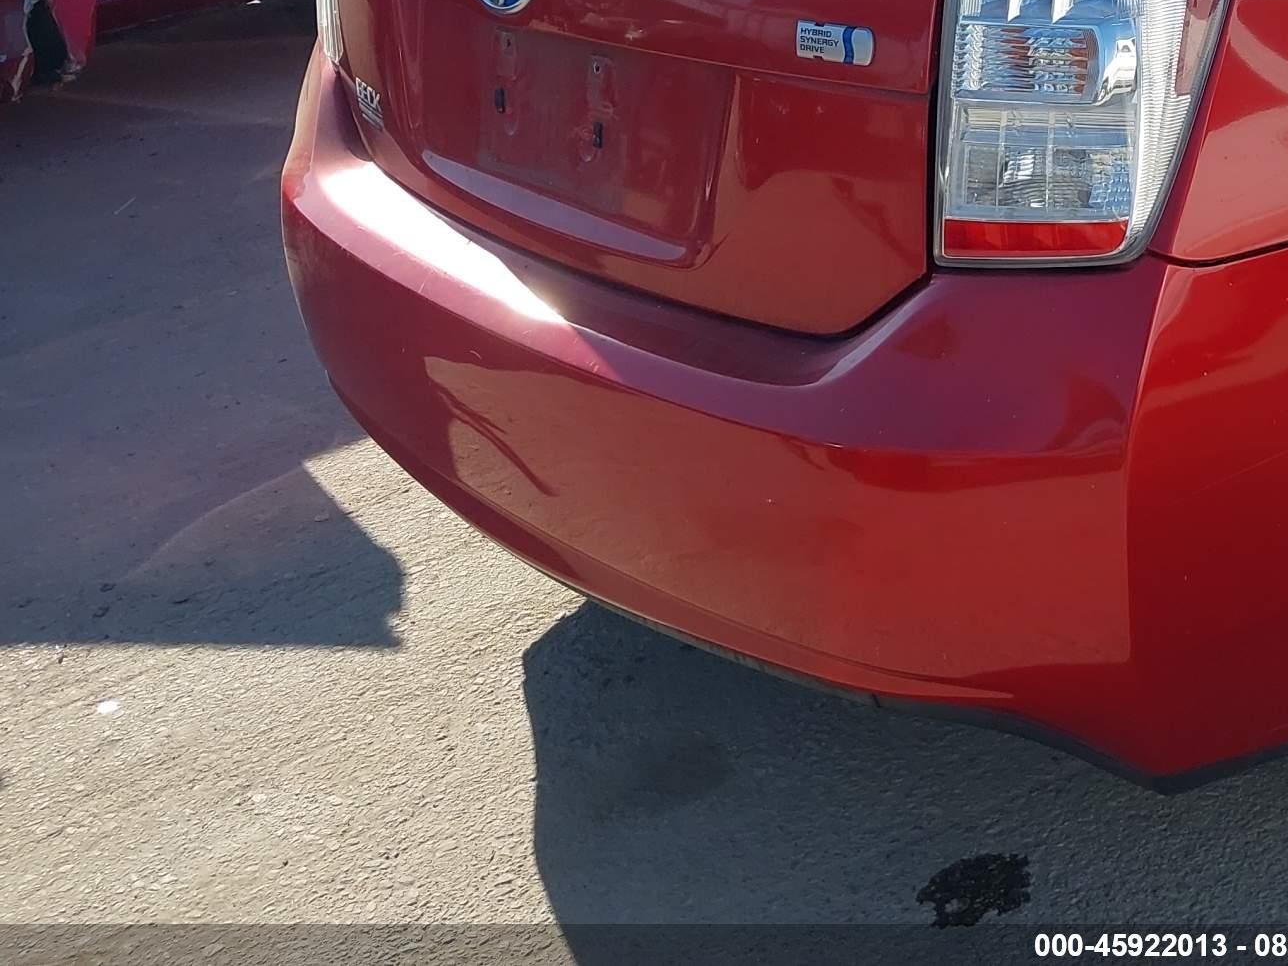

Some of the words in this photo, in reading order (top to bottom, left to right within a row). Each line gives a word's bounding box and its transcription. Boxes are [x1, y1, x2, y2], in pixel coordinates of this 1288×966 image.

[800, 27, 832, 38] HYBRID
[800, 35, 840, 47] SYNERGY
[800, 43, 825, 54] DRIVE
